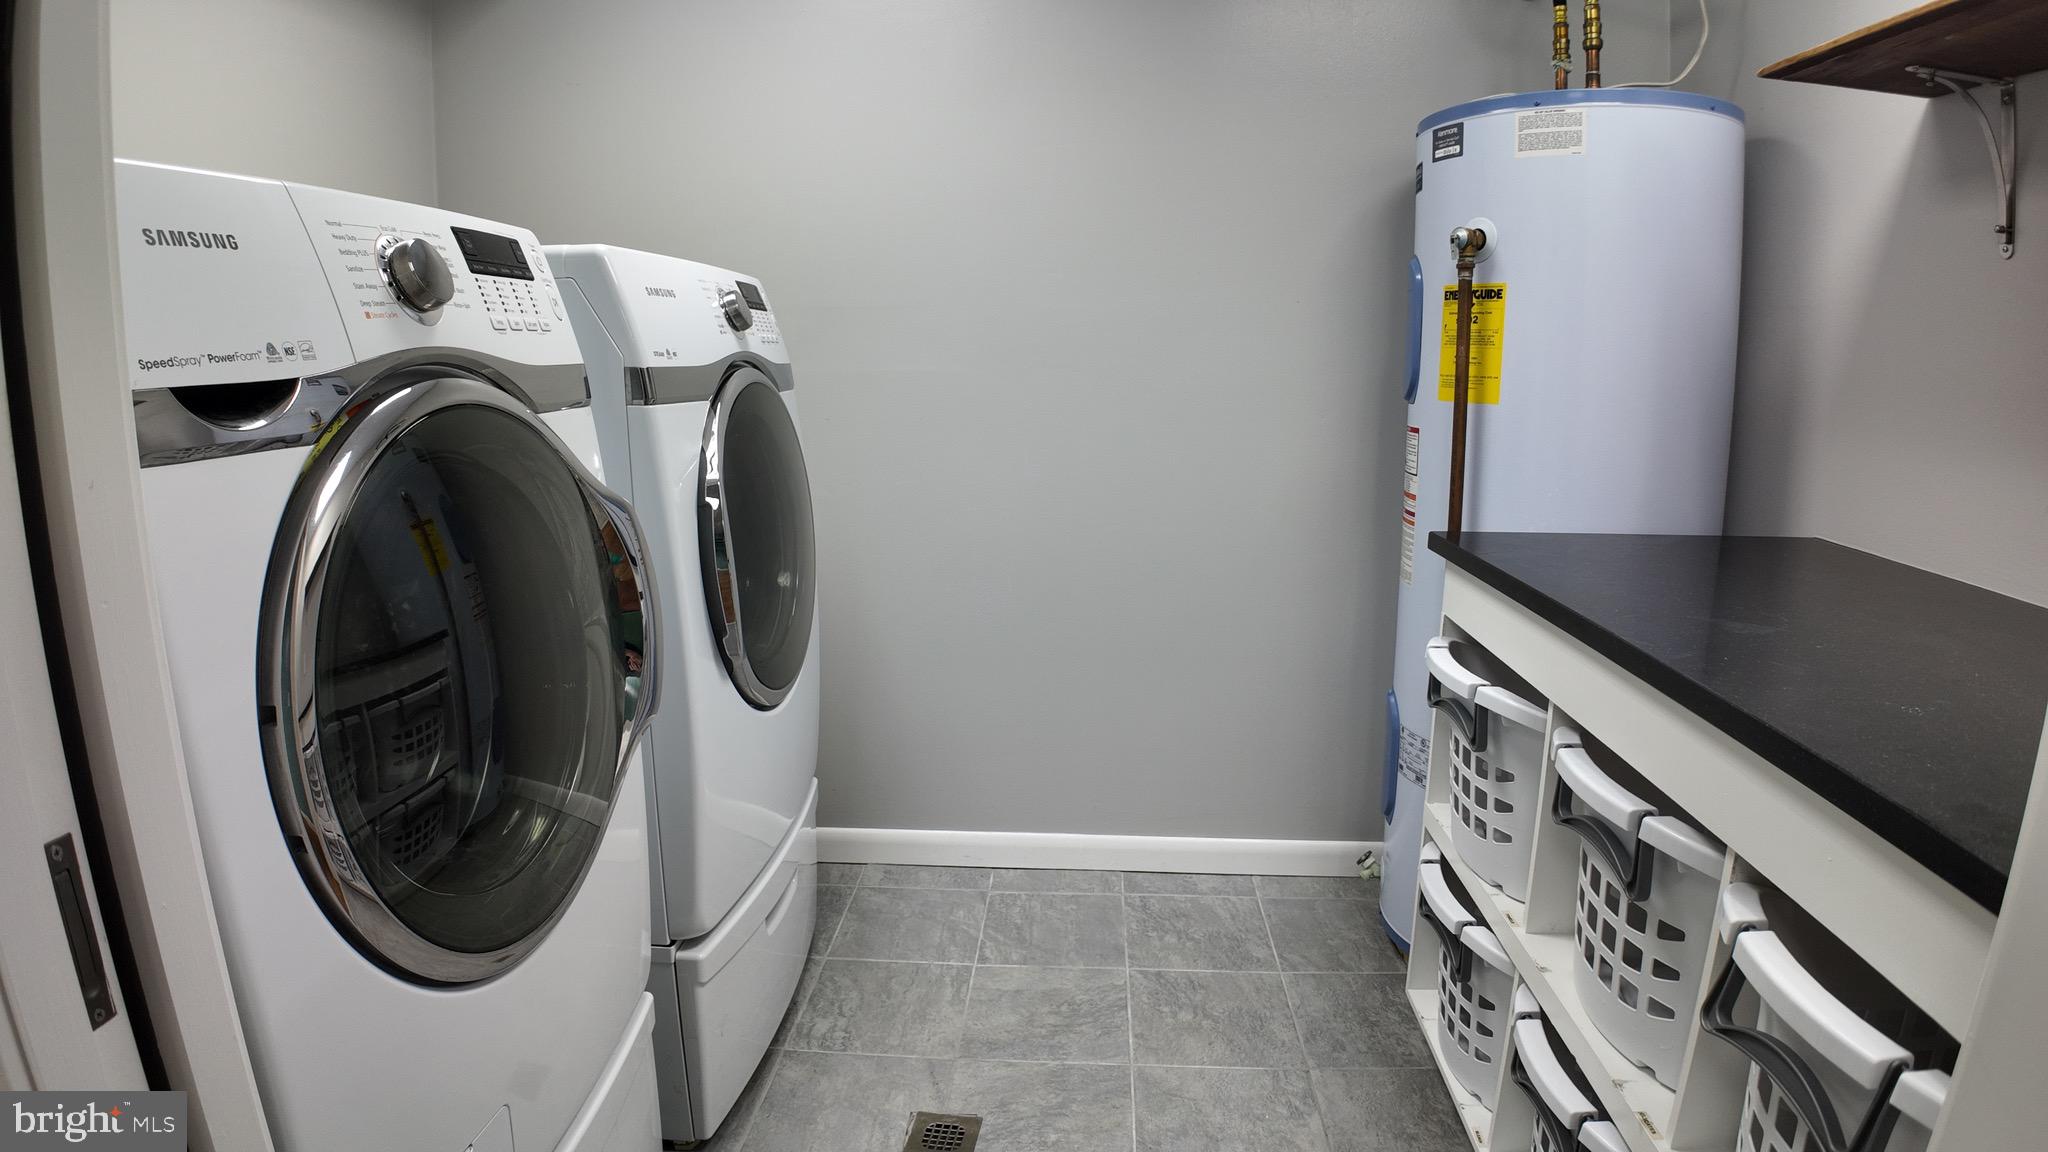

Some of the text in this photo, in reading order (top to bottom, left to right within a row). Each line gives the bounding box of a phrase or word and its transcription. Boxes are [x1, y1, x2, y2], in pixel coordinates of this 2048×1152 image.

[141, 228, 239, 250] SAMSUNG
[645, 286, 676, 298] SAMSUNG
[1444, 288, 1503, 301] ENEGUIDE
